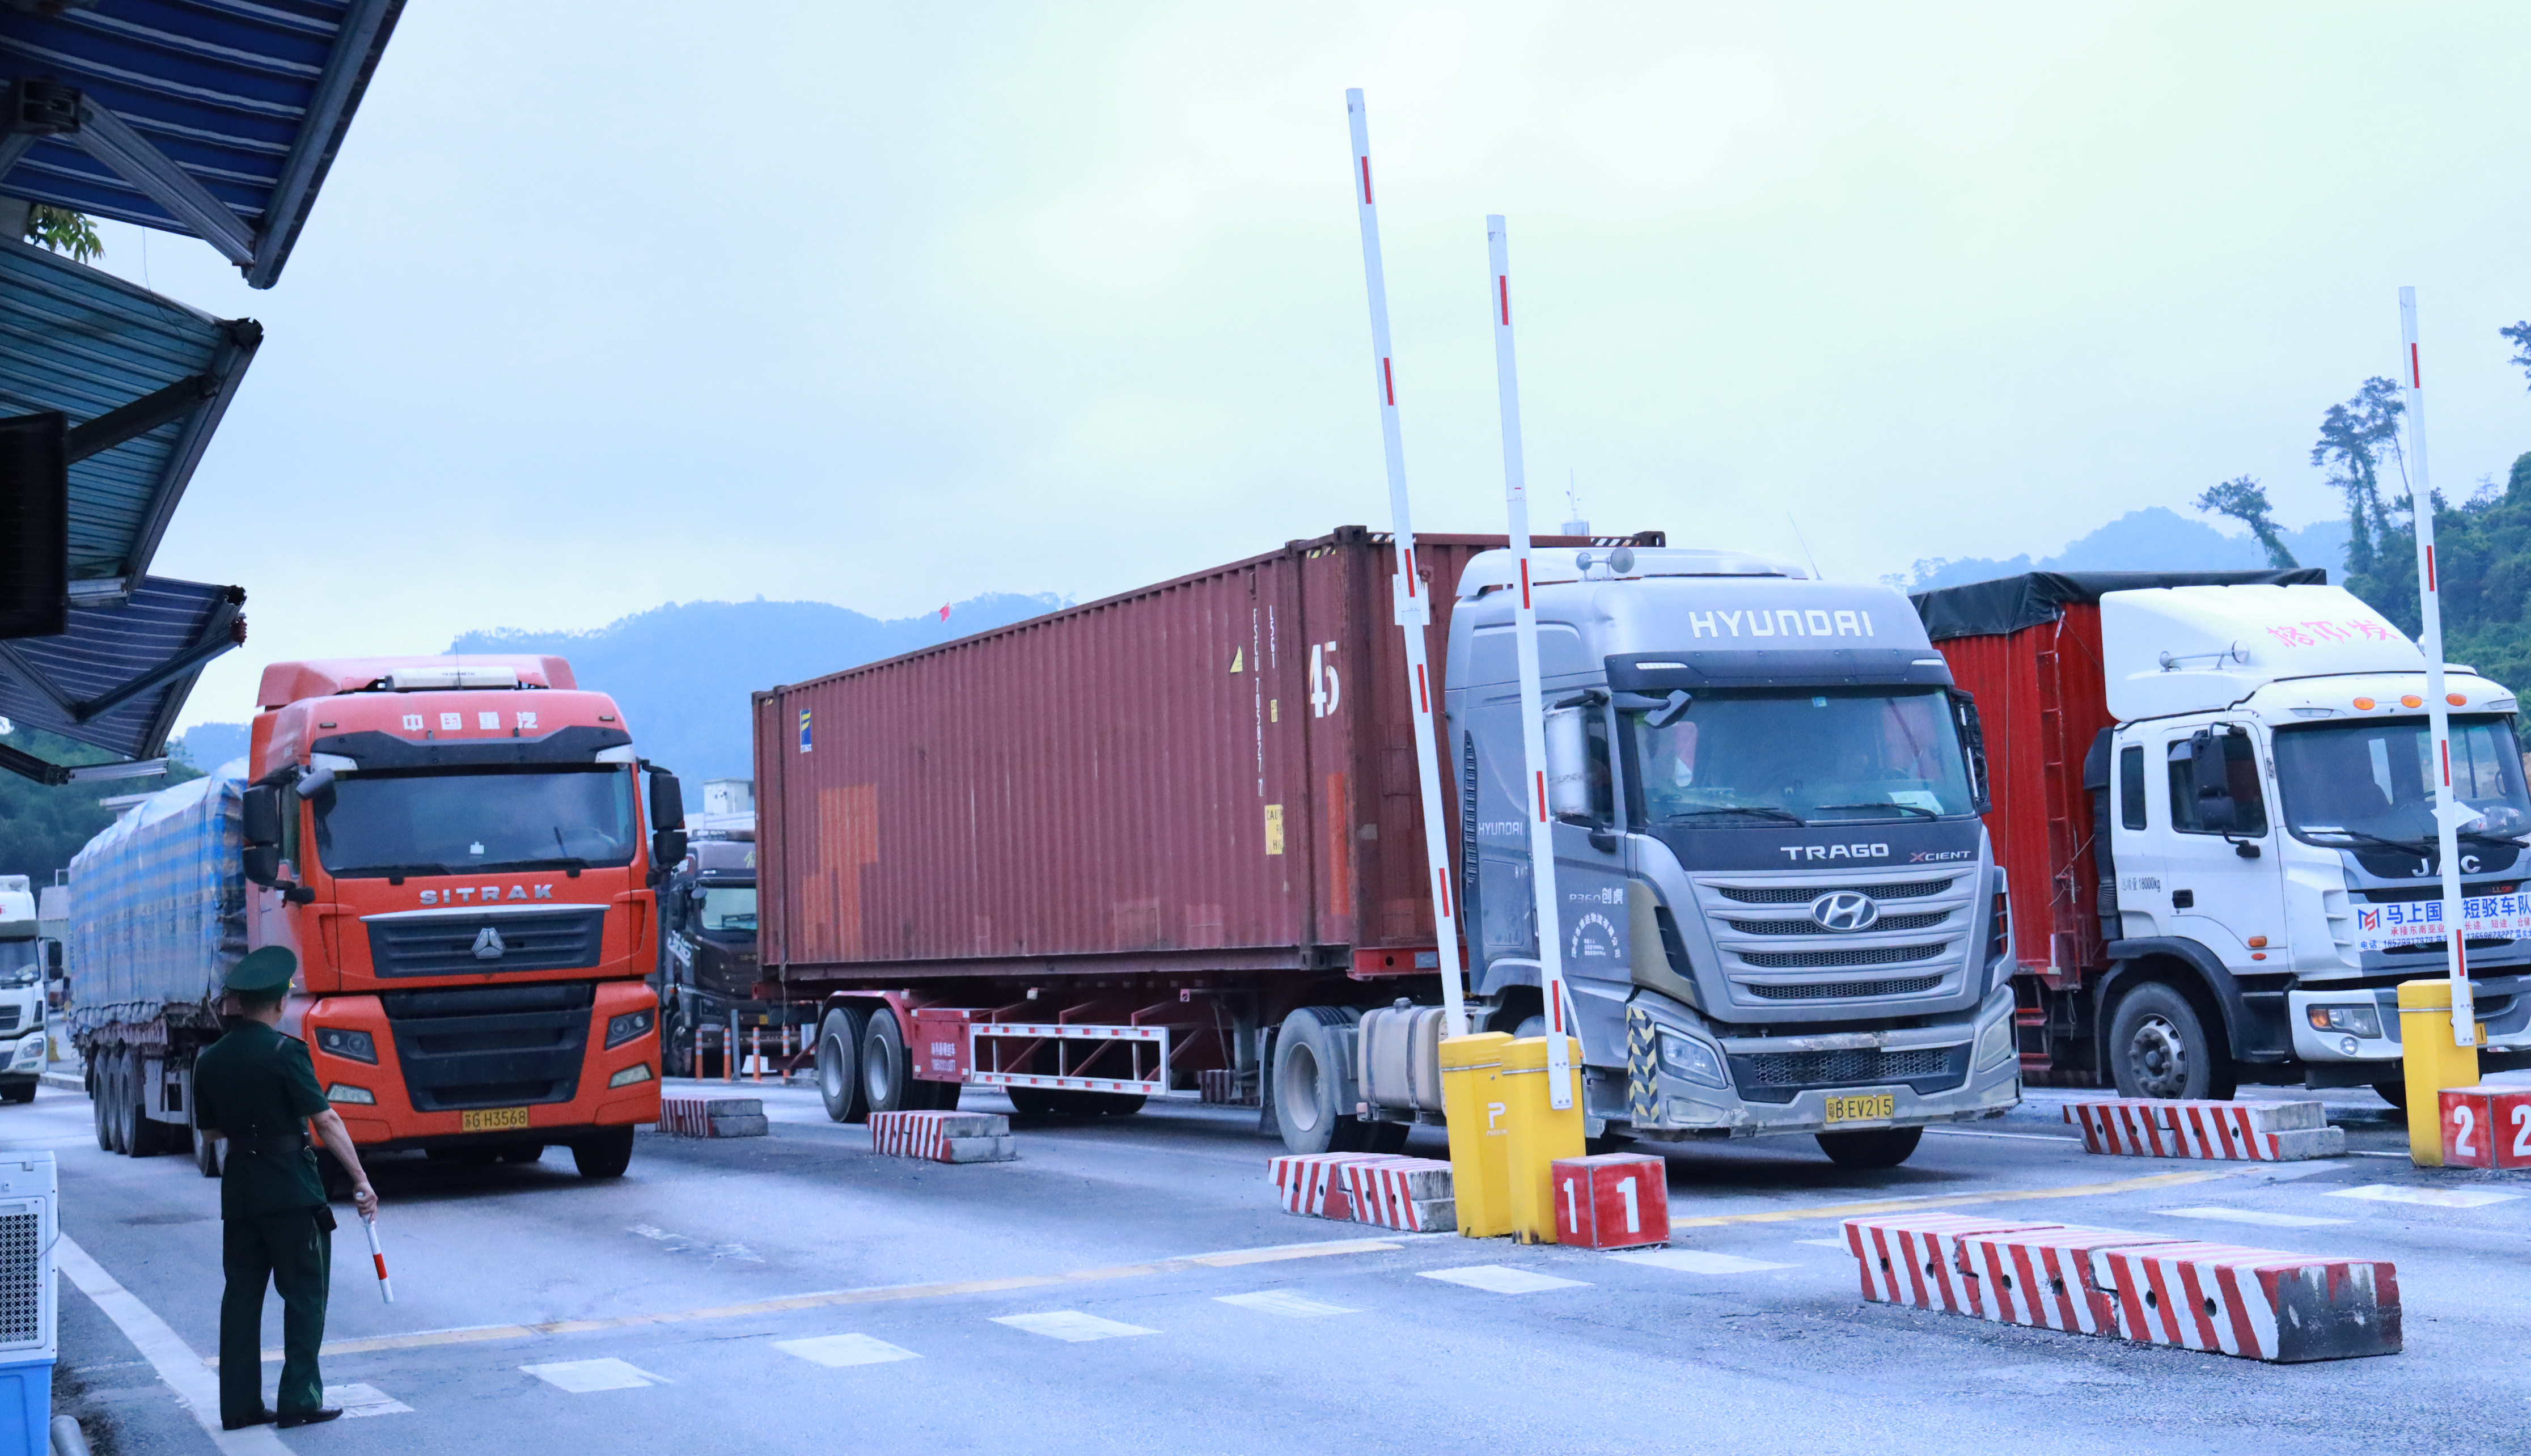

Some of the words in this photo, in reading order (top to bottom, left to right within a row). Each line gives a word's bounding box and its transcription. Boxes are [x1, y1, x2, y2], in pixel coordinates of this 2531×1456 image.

[1688, 610, 1874, 638] HYUNDAI
[1310, 641, 1339, 718] 45
[403, 712, 537, 731] 中国重汽
[1478, 822, 1523, 835] HYUNDAI
[1780, 843, 1889, 860] TRAGO
[1910, 851, 1971, 862] XCIENT
[420, 884, 553, 904] SITRAK
[2386, 894, 2531, 924] 马上国短驳车队
[2454, 1105, 2476, 1157] 2
[2511, 1104, 2531, 1157] 2
[1563, 1177, 1578, 1234] 1
[1616, 1176, 1640, 1233] 1
